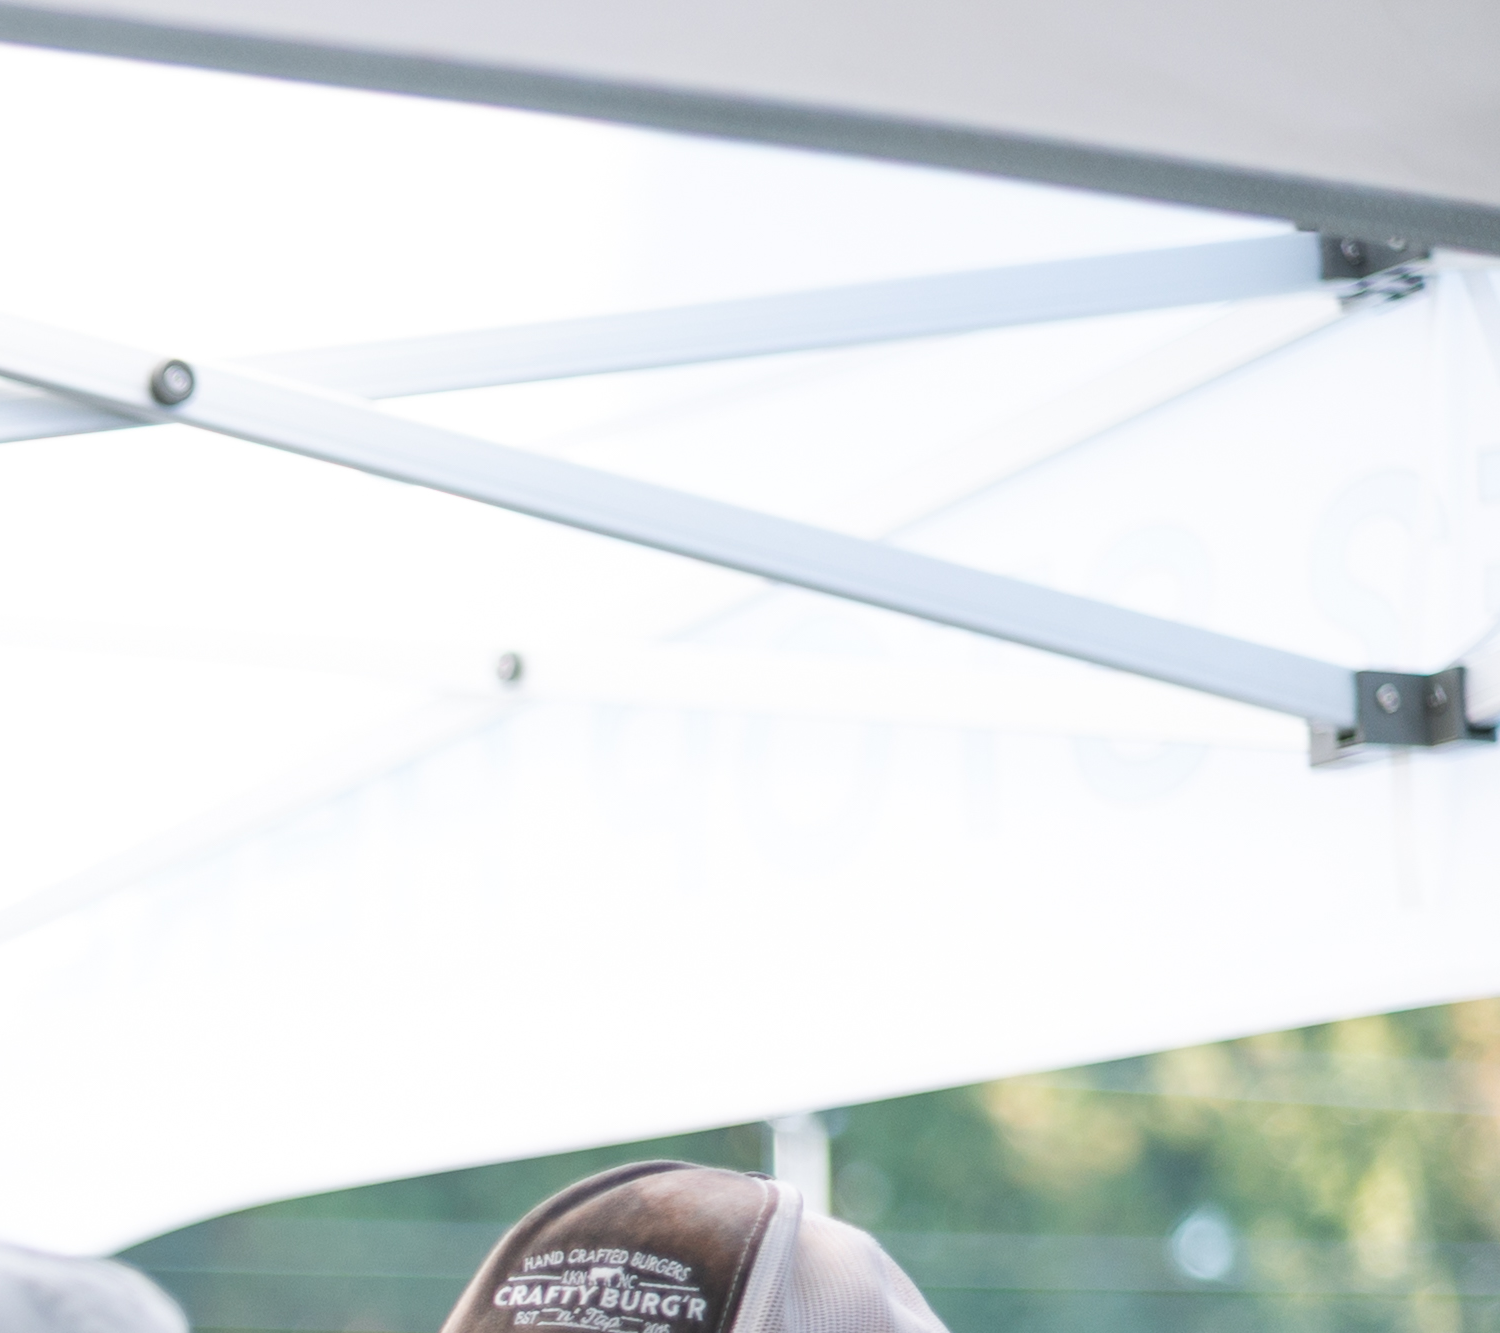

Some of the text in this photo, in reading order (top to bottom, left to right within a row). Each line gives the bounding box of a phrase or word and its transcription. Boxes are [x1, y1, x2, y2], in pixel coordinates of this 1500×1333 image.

[524, 1248, 692, 1282] HAND CRAFTED BURGERS
[493, 1285, 708, 1321] CRAFTY BURG'R
[513, 1310, 540, 1326] EST
